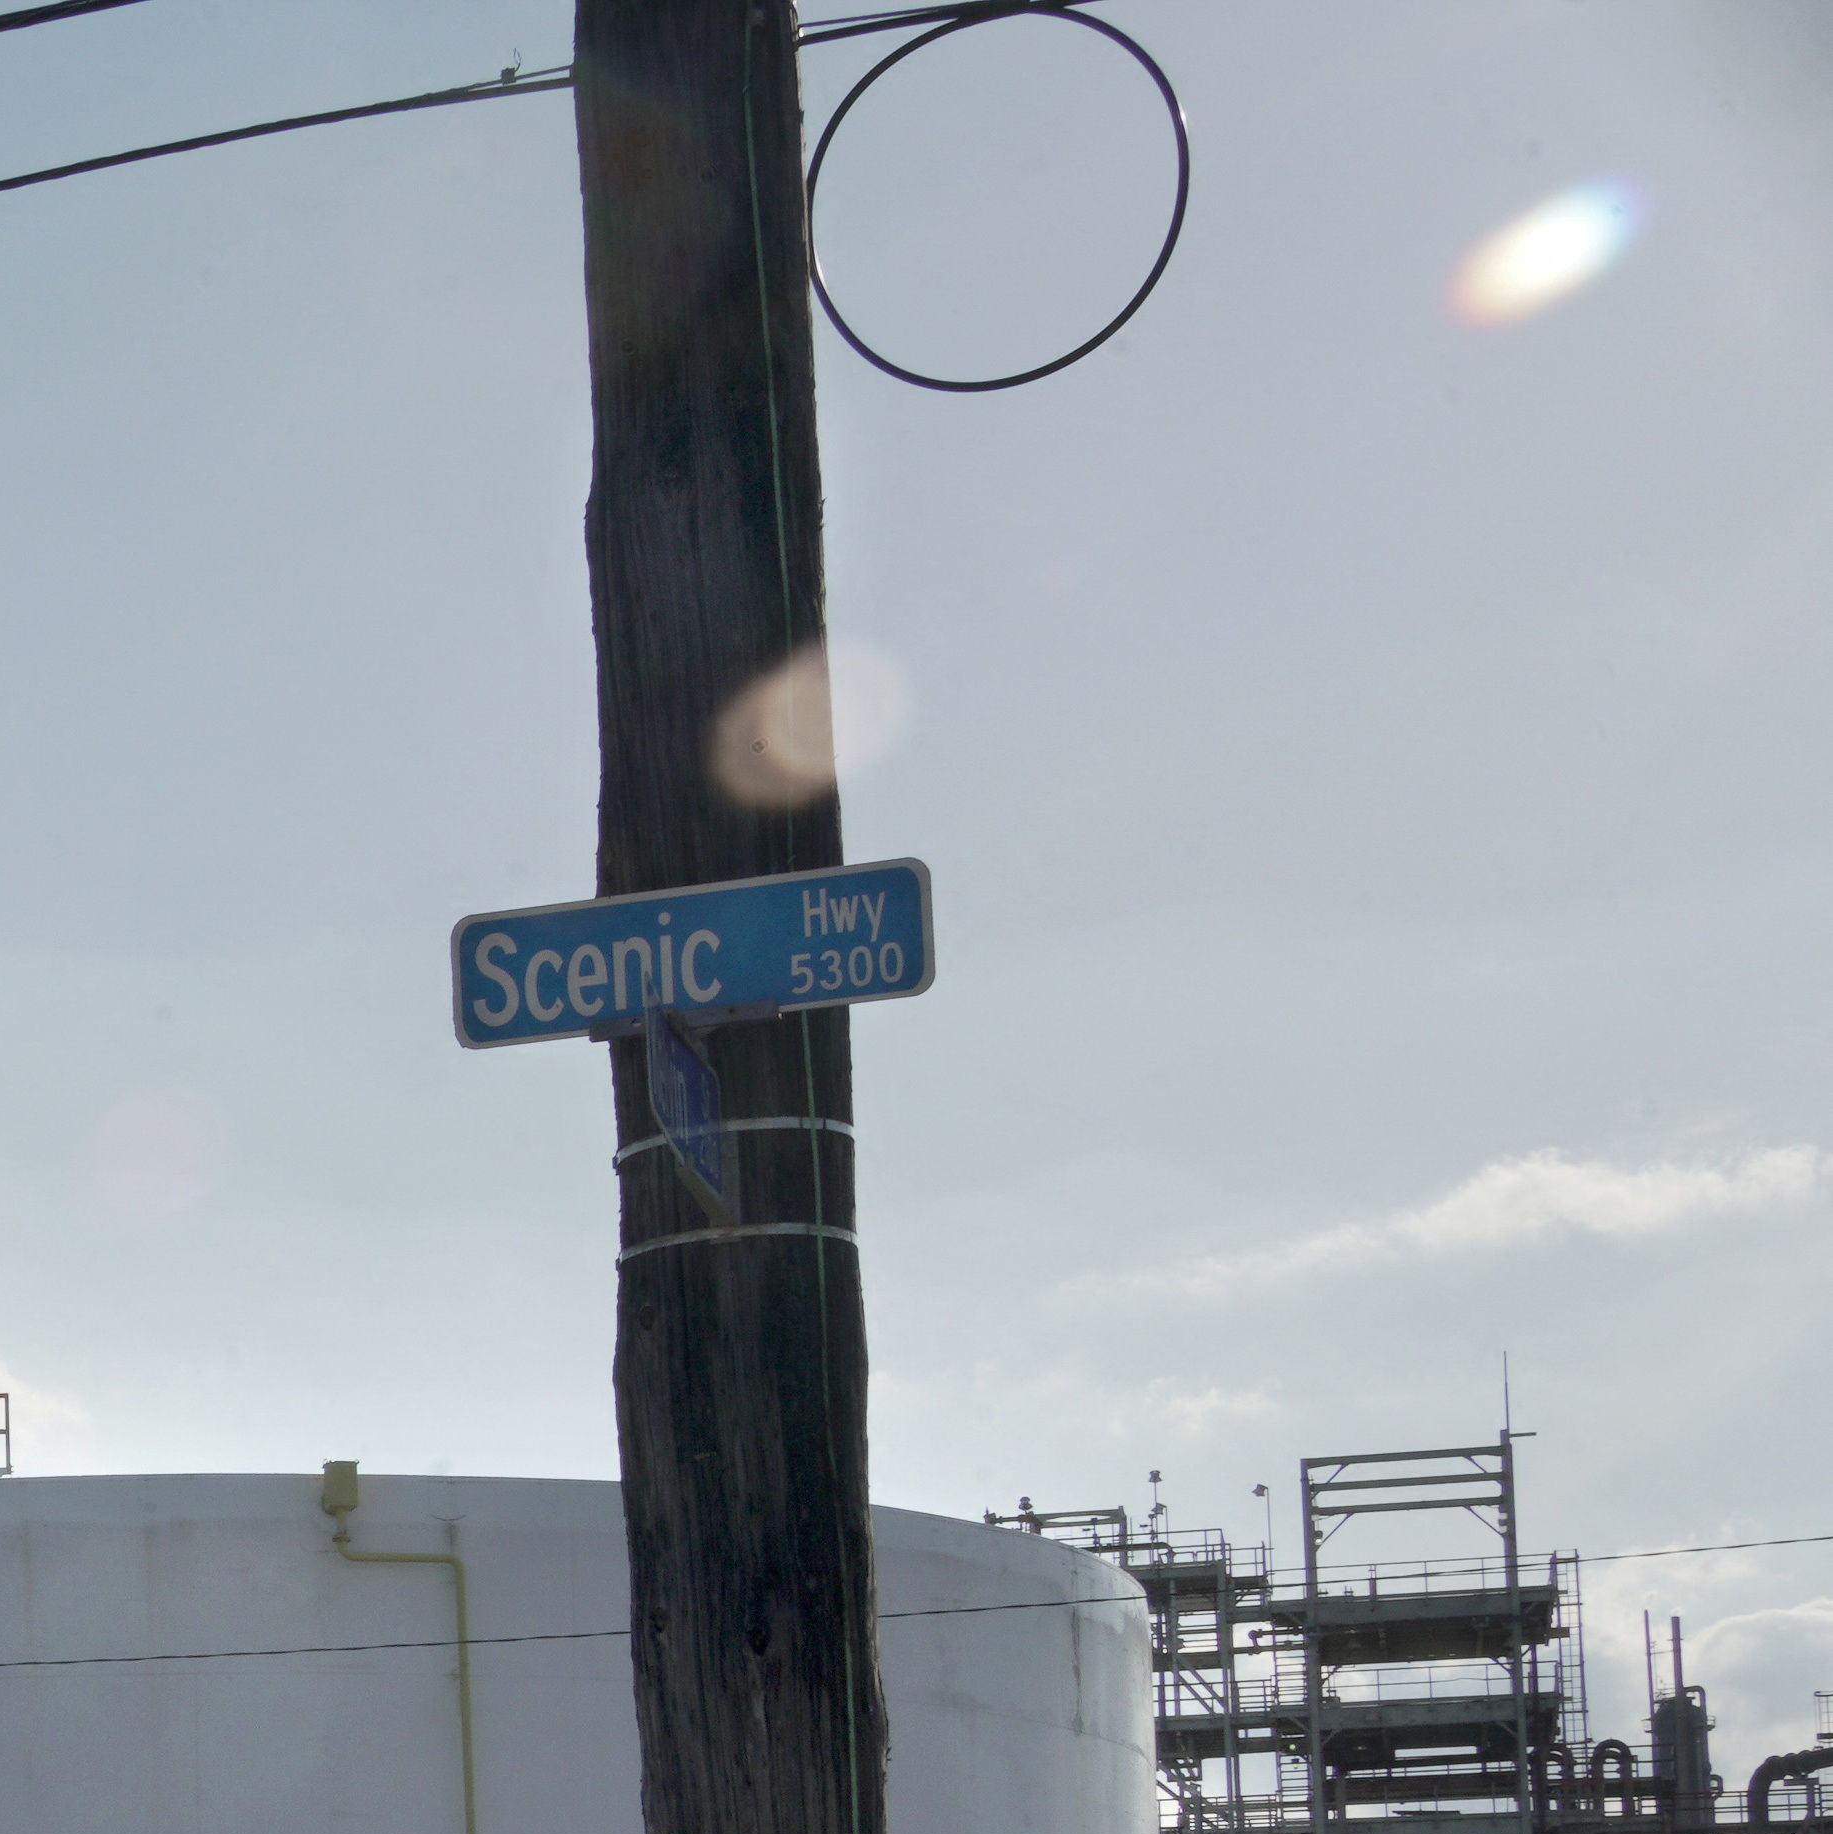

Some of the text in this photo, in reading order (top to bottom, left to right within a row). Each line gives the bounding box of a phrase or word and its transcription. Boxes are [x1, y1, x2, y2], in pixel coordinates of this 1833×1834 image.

[473, 888, 886, 1028] Scenic Hwy
[790, 941, 905, 994] 5300
